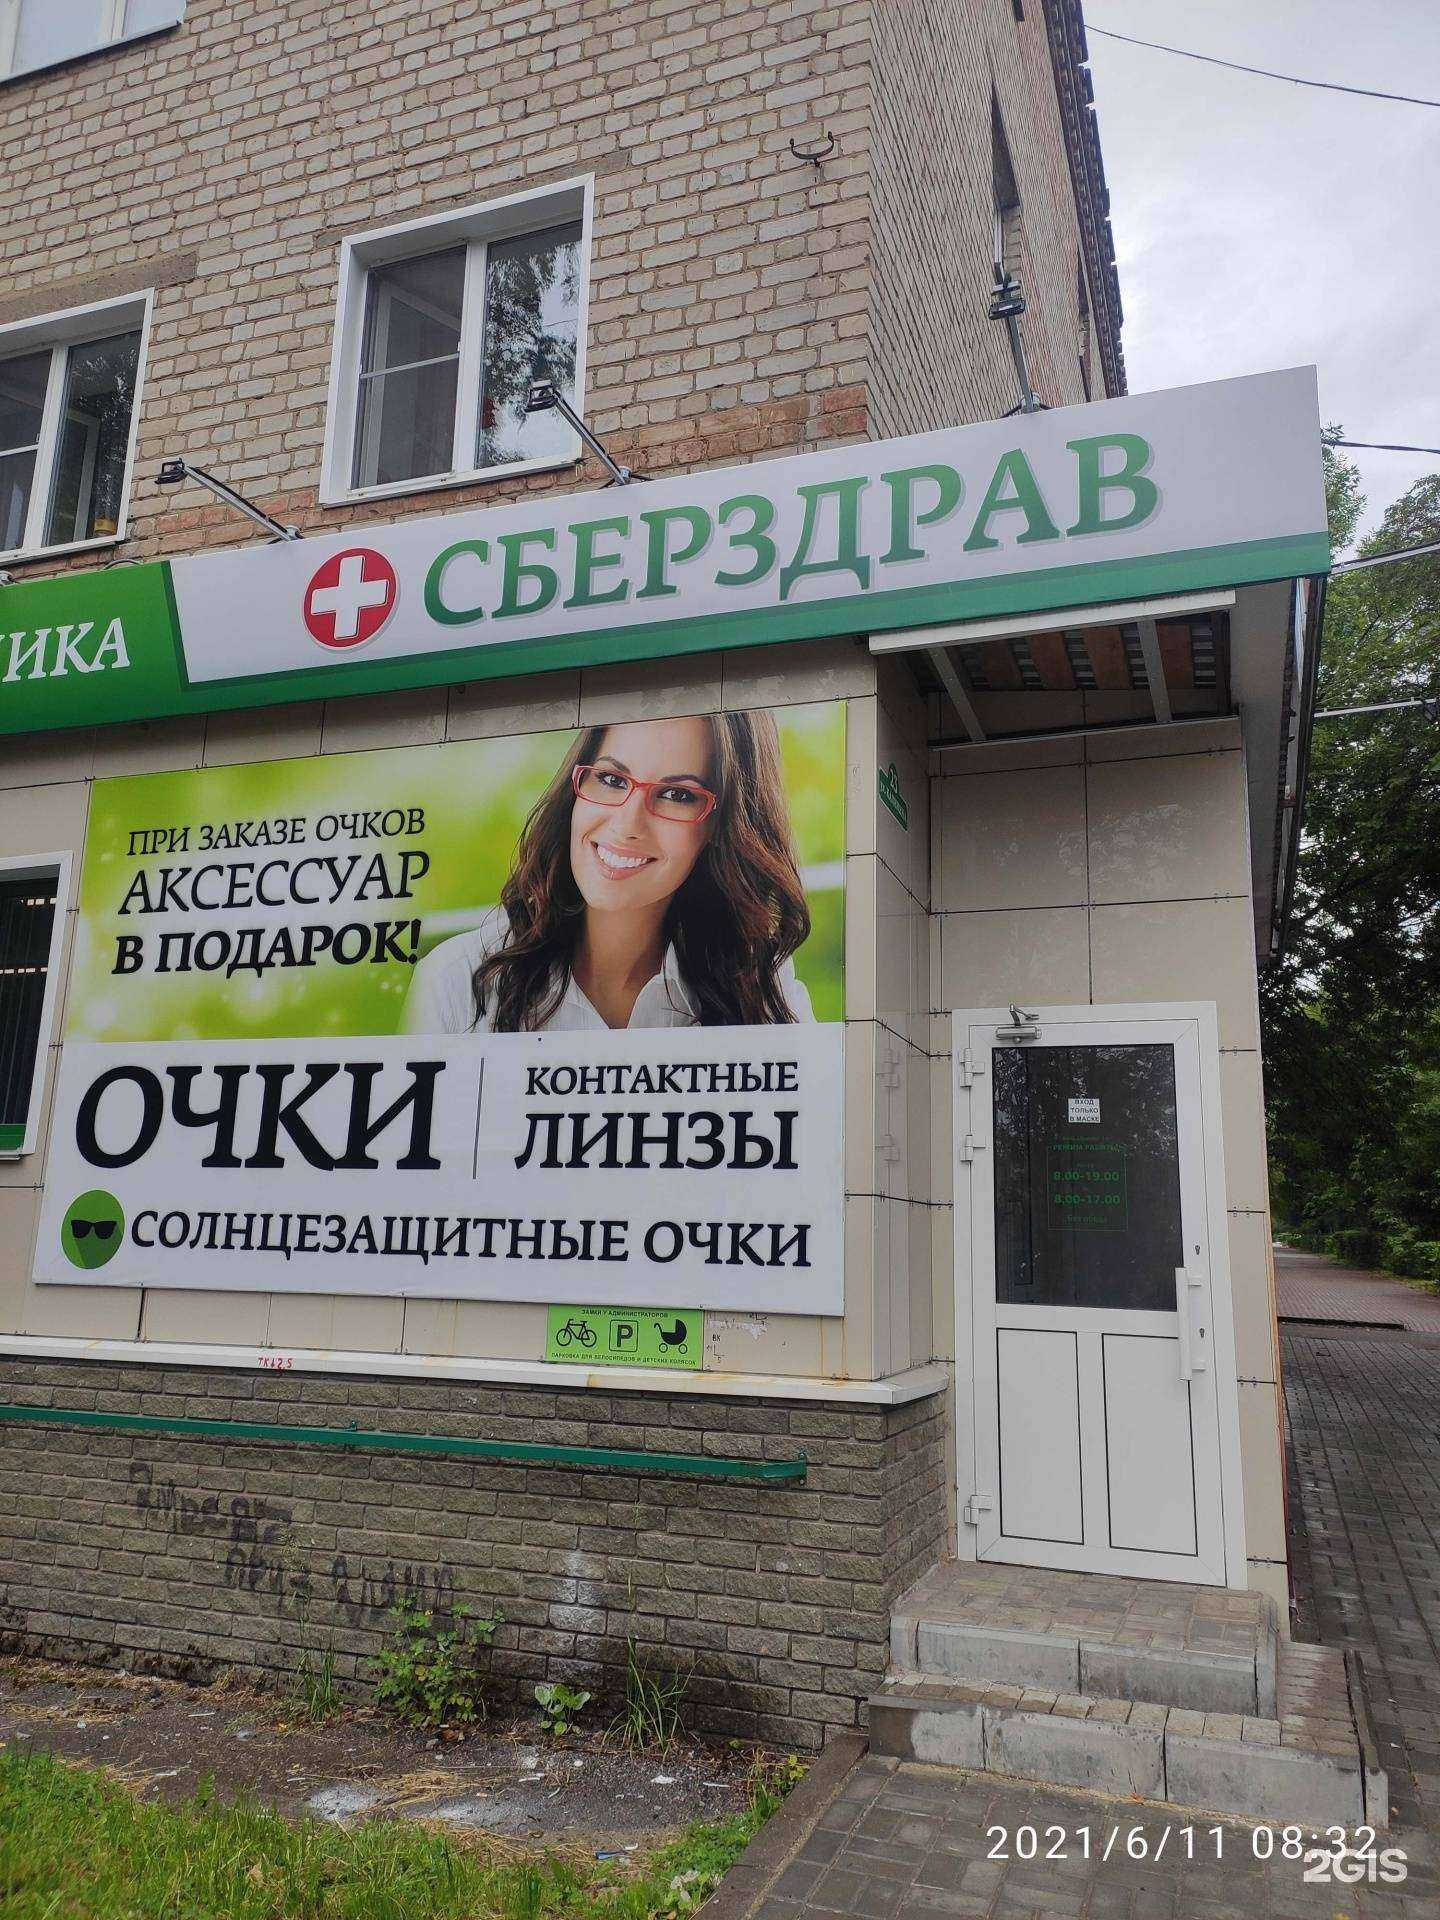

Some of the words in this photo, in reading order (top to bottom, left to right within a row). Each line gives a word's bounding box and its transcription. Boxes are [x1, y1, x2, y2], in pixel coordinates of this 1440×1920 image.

[423, 434, 1158, 625] СБЕРЗДРАВ
[0, 618, 131, 683] ИКА
[126, 827, 192, 856] ПРИ
[198, 818, 307, 851] ЗАКАЗЕ
[315, 808, 426, 842] ОЧКОВ
[117, 851, 430, 915] АКСЕССУАР
[111, 935, 144, 975] В
[155, 919, 422, 979] ПОДАРОК!
[525, 1062, 799, 1095] КОНТАКТНЫЕ
[76, 1062, 447, 1171] ОЧКИ
[514, 1111, 799, 1169] ЛИНЗЫ
[132, 1211, 629, 1266] СОЛНЦЕЗАЩИТНЫЕ
[644, 1221, 812, 1267] ОЧКИ
[608, 1310, 668, 1318] АДМИНИСТРАТОРОВ
[594, 1354, 635, 1362] ВЕЛОСИПЕДОВ
[643, 1356, 668, 1364] ДЕТСКИХ
[670, 1358, 696, 1366] КОЛЯСОК
